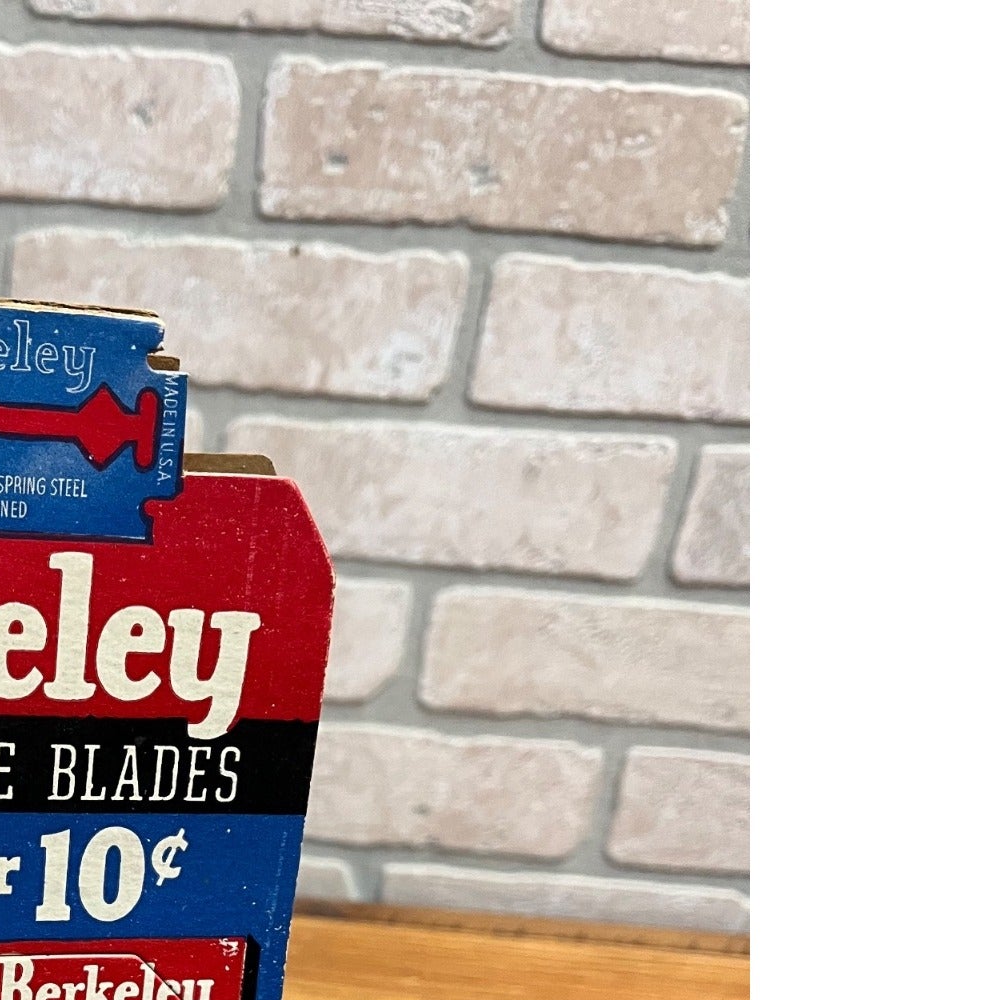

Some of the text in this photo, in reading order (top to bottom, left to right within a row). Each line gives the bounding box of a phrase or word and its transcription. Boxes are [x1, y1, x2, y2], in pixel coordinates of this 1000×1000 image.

[157, 374, 180, 486] MADE IN U.S.A.
[50, 478, 88, 498] STEEL
[48, 744, 243, 804] BLADES
